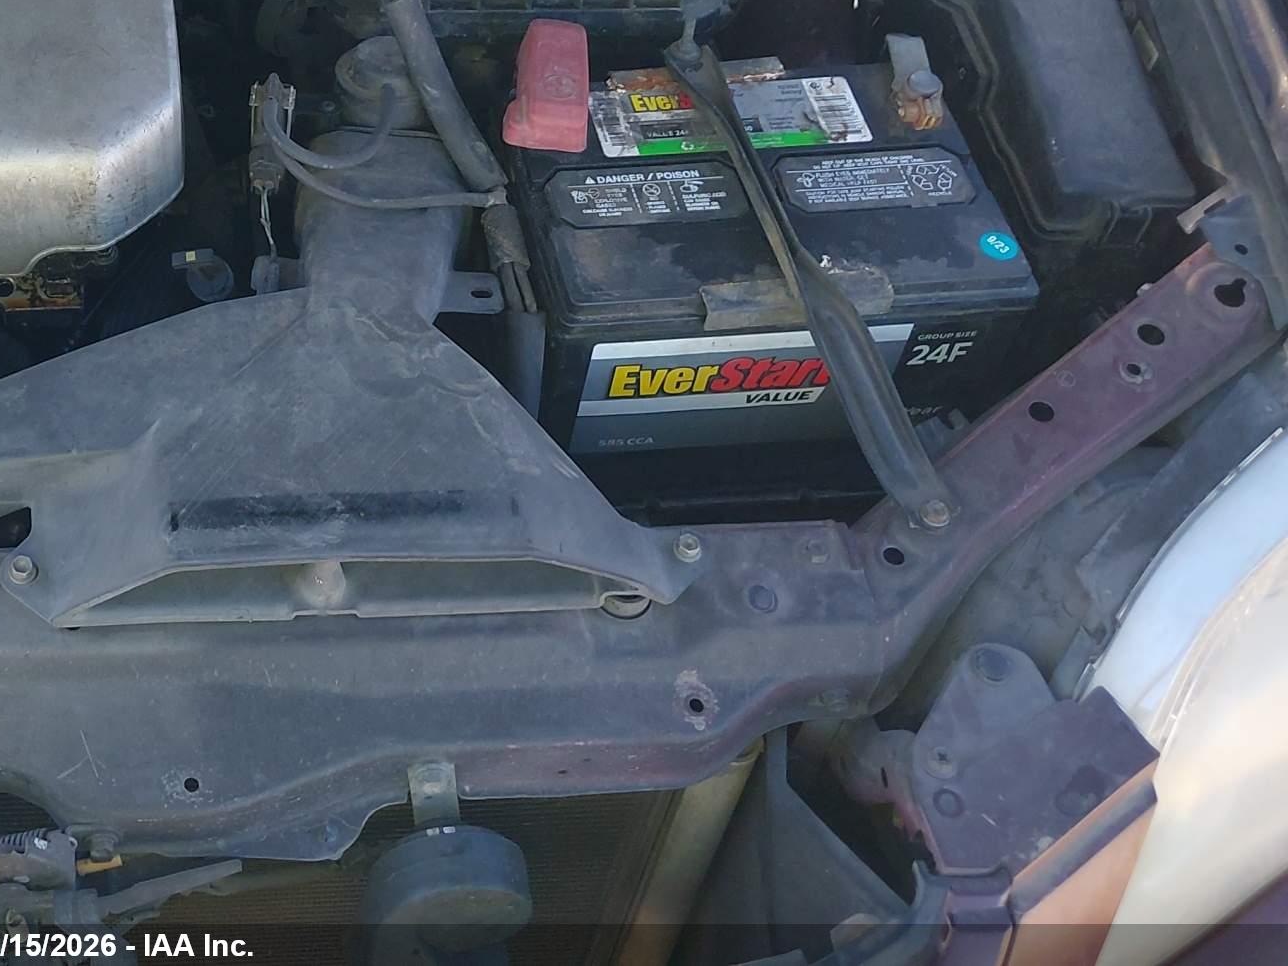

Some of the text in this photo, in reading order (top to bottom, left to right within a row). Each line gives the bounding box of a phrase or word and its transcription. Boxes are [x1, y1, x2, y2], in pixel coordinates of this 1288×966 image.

[596, 172, 645, 184] DANGER
[655, 169, 700, 180] POISON
[917, 330, 978, 341] GROUP SIZE
[906, 341, 974, 366] 24F
[745, 390, 814, 404] VALUE
[626, 436, 654, 445] CCA
